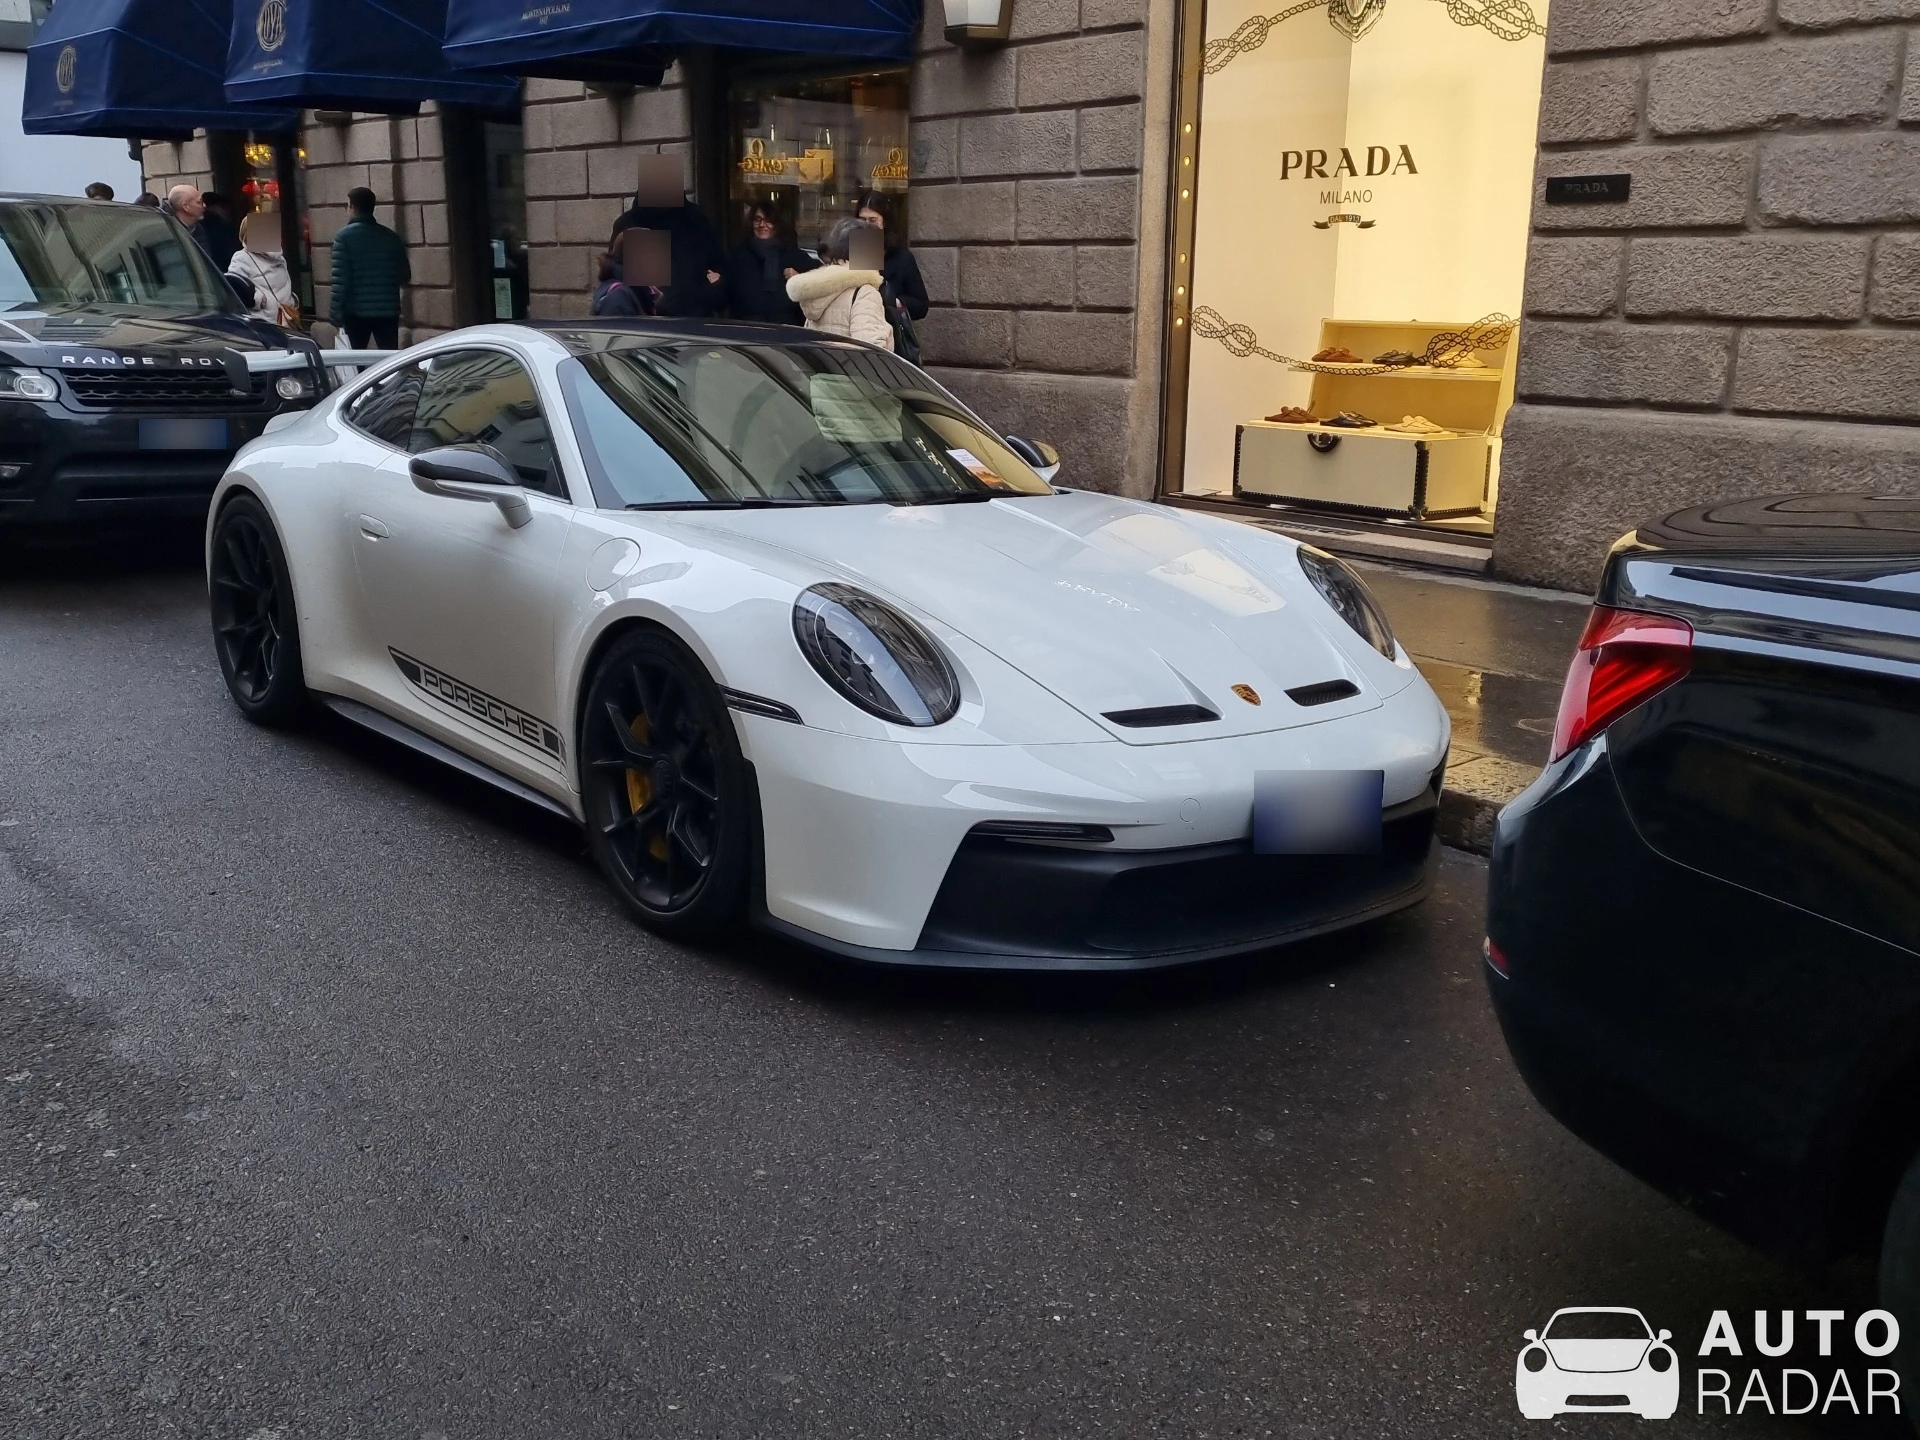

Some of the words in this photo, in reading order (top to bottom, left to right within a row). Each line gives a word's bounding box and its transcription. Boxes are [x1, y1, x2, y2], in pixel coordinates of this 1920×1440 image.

[1279, 144, 1419, 180] PRADA
[1563, 182, 1609, 194] PRADA
[1319, 189, 1373, 205] MILANO
[61, 355, 155, 365] RANGE
[424, 669, 541, 743] PORSCHE
